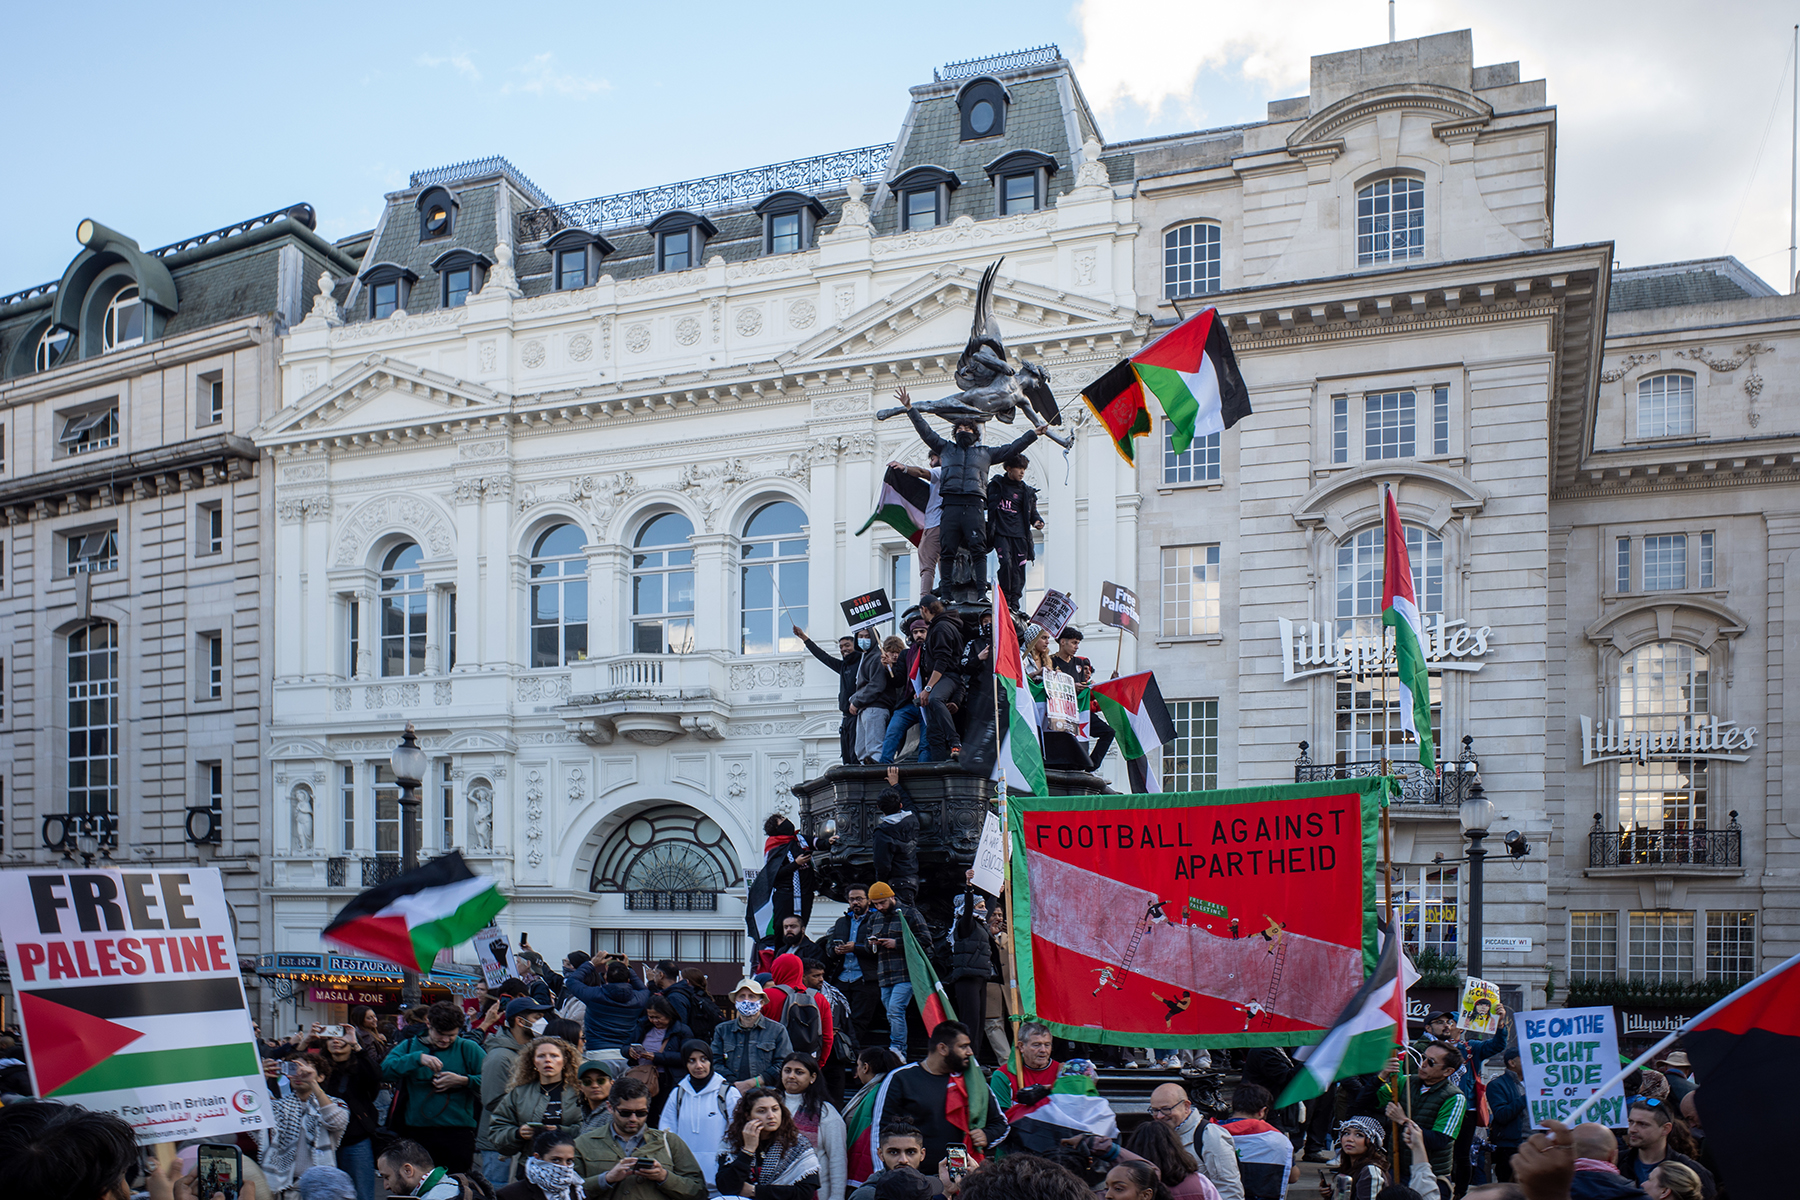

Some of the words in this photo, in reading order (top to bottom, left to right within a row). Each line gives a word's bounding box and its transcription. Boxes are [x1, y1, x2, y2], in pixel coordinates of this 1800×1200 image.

[849, 599, 882, 616] BOMBING
[853, 595, 871, 607] STOP
[1115, 588, 1136, 607] Free
[859, 608, 877, 620] GAZA
[1278, 613, 1492, 682] Lillywites
[1581, 714, 1760, 768] Lillywhites
[1037, 822, 1193, 850] FOOTBALL
[1211, 809, 1345, 845] AGAINST
[1174, 845, 1337, 881] APARTHEID
[27, 873, 202, 935] FREE
[1189, 896, 1204, 905] FREE
[1207, 902, 1225, 911] FREE
[1189, 902, 1222, 915] PALESTINE
[16, 935, 231, 982] PALESTINE
[281, 956, 296, 966] EST.
[298, 957, 316, 966] 1874
[316, 990, 354, 1002] MASALA
[359, 993, 384, 1003] ZONE
[1525, 1020, 1546, 1040] BE
[1548, 1019, 1573, 1038] ON
[1572, 1014, 1605, 1036] THE
[1622, 1011, 1691, 1035] Lillywhit
[1530, 1041, 1600, 1065] RIGHT
[1543, 1064, 1602, 1088] SIDE
[1564, 1086, 1578, 1097] OF
[121, 1102, 167, 1117] Forum
[170, 1100, 182, 1111] in
[185, 1095, 227, 1109] Britain
[240, 1115, 263, 1126] PFB
